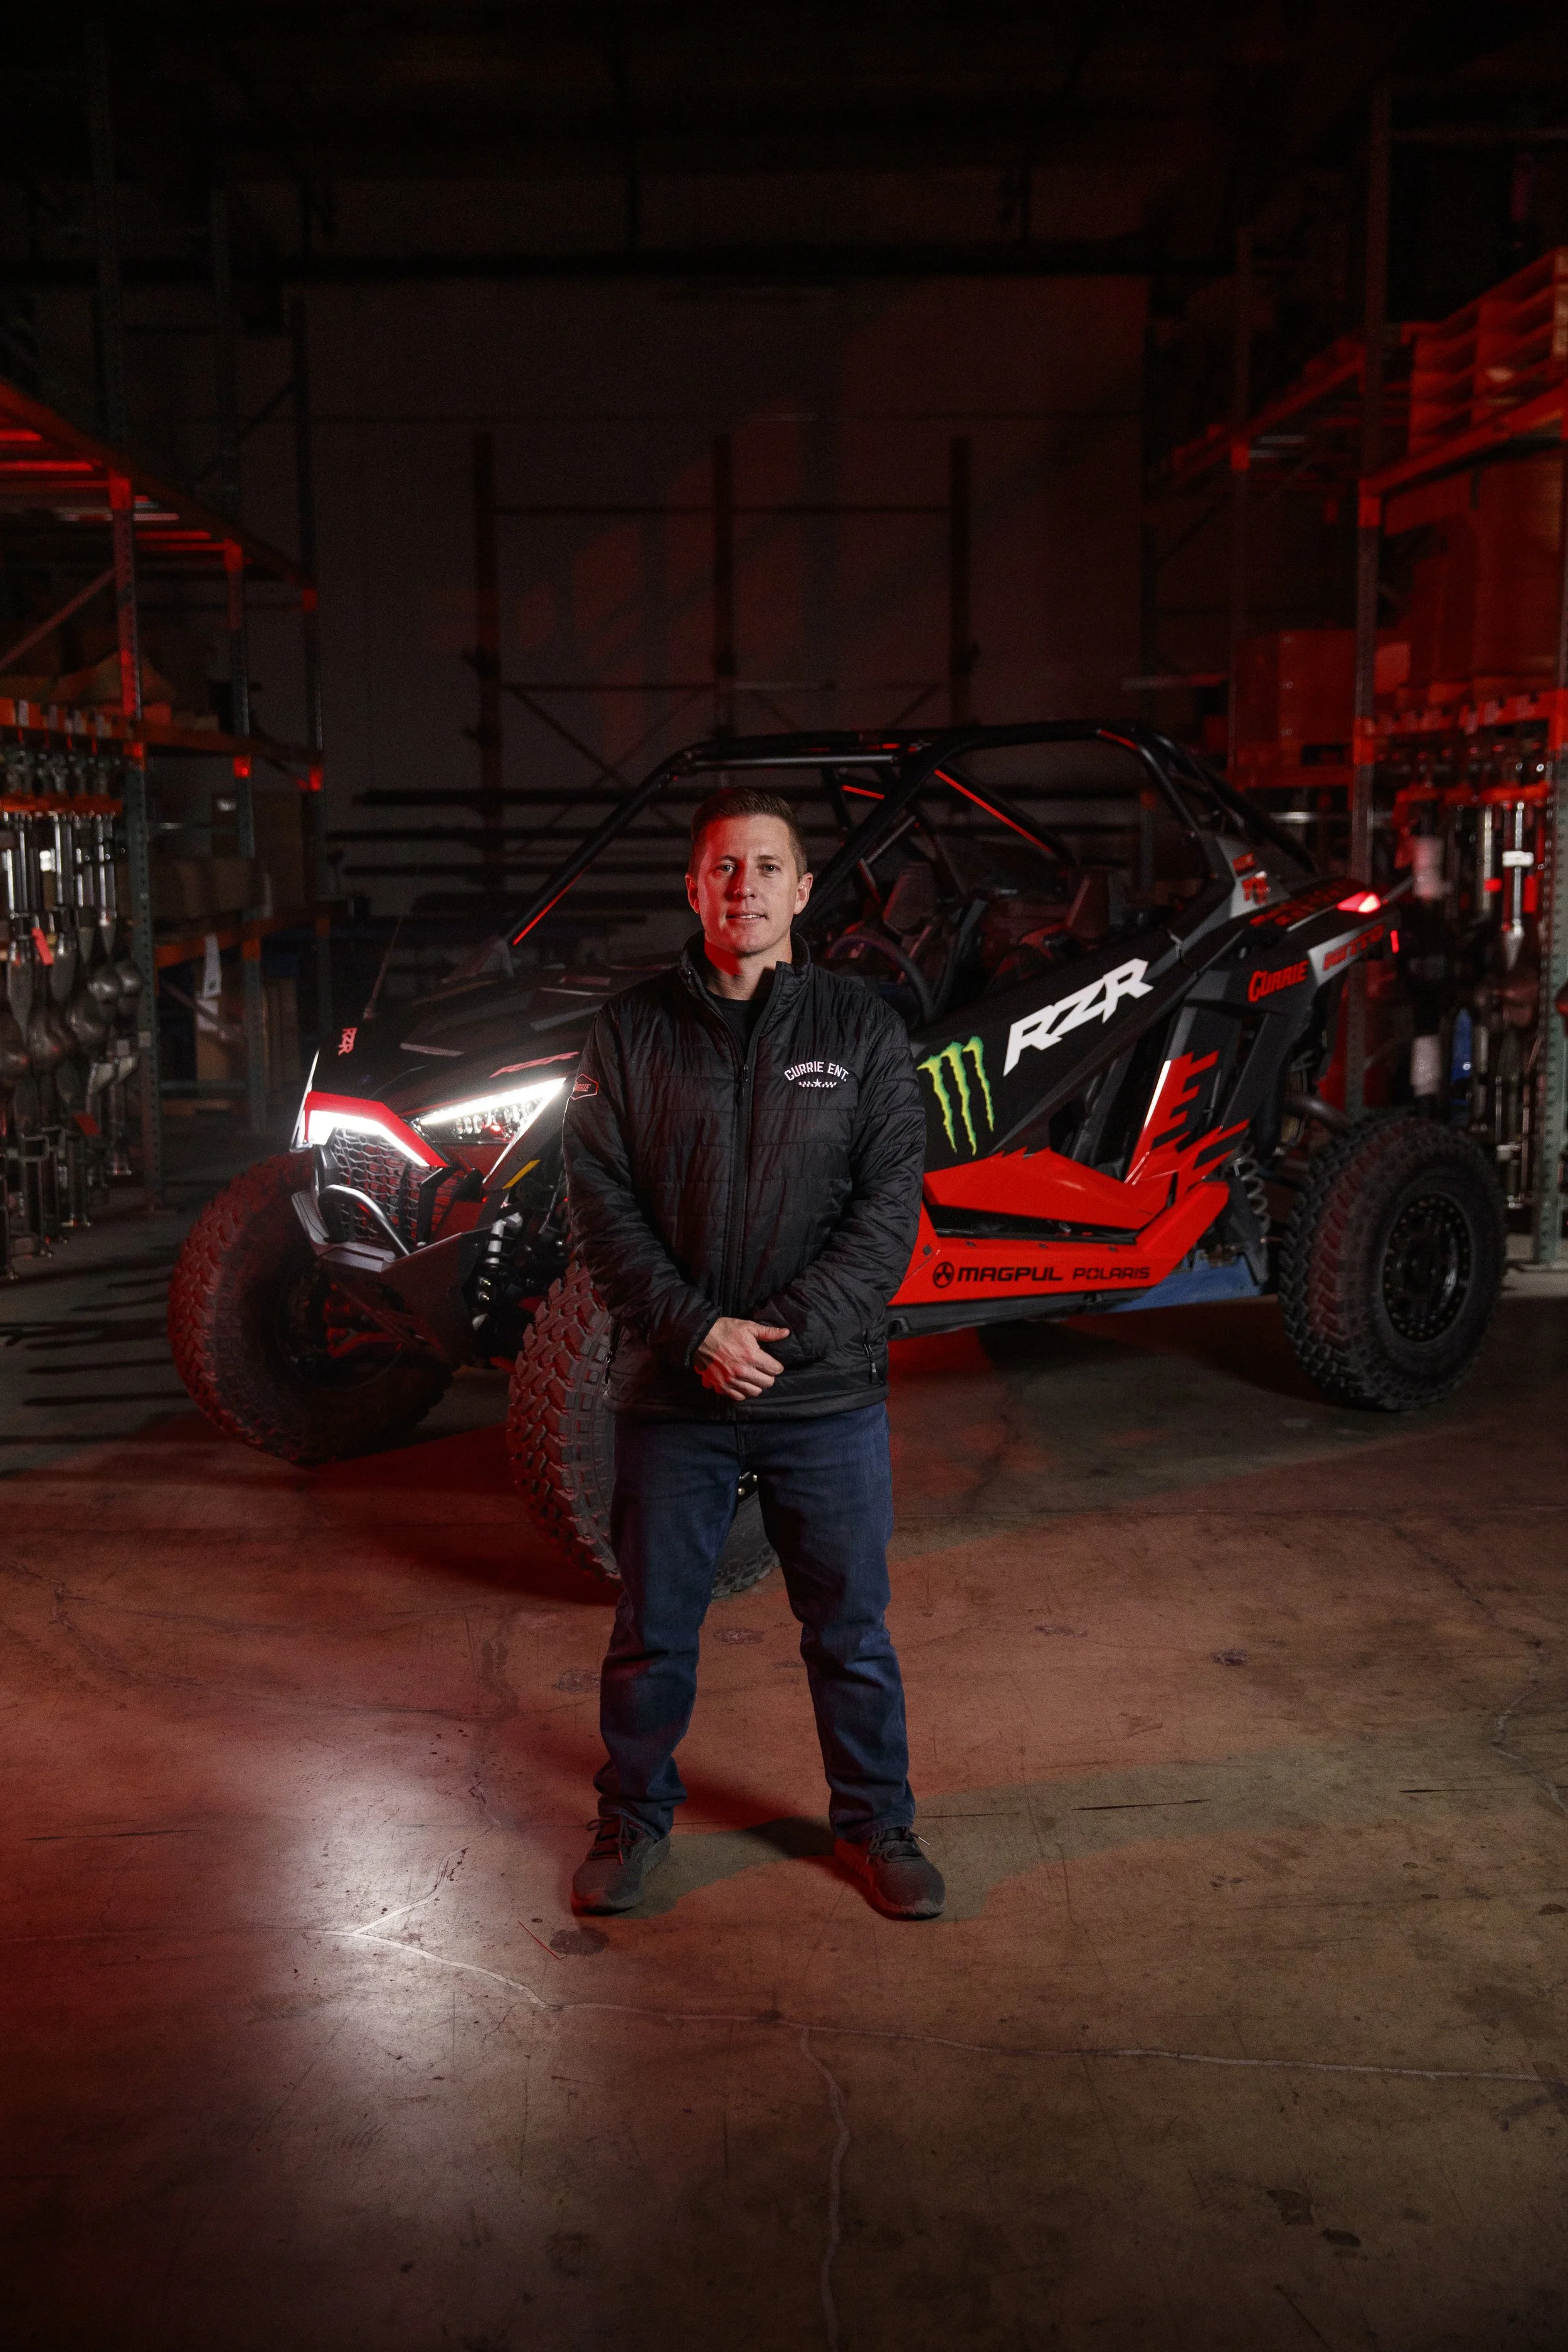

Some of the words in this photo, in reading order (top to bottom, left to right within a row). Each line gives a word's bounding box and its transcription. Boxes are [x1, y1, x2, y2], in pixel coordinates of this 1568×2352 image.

[1003, 958, 1155, 1077] RZR
[784, 1061, 824, 1081] CURRIE
[827, 1062, 849, 1082] ENT.
[957, 1266, 1063, 1282] MAGPUL
[1073, 1266, 1151, 1281] POLARIS
